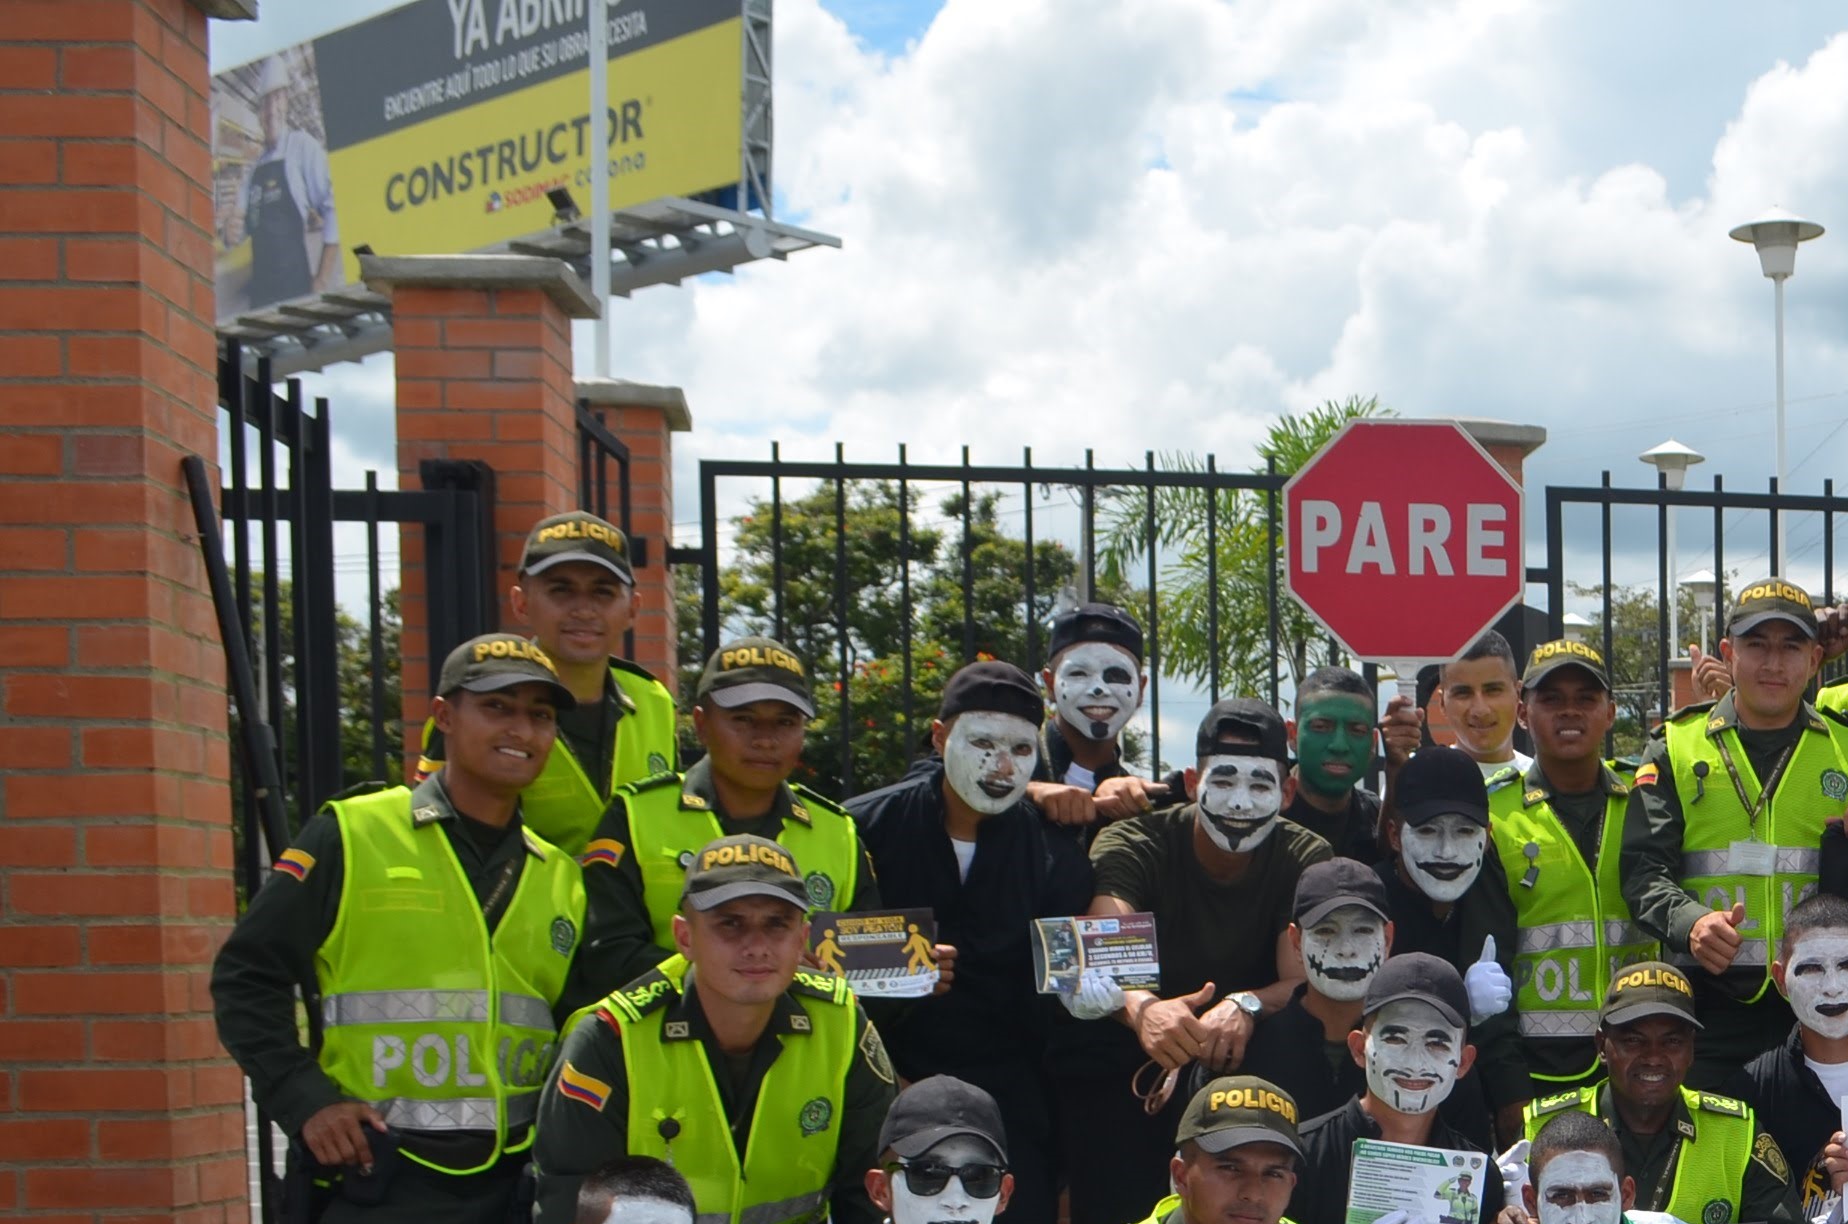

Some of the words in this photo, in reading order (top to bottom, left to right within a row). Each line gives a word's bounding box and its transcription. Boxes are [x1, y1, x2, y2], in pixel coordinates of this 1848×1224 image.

[447, 0, 488, 59] YA
[384, 79, 445, 120] ENCUENTRE
[445, 63, 472, 100] AQUÍ
[473, 60, 501, 91] TODO
[502, 55, 517, 82] LO
[517, 49, 542, 78] QUE
[541, 42, 558, 70] SU
[559, 29, 591, 62] OBRA
[575, 151, 645, 188] coona
[537, 520, 622, 552] POLICIA
[1300, 499, 1507, 577] PARE
[1739, 582, 1812, 610] POLICIA
[721, 647, 805, 678] POLICIA
[1534, 638, 1605, 665] POLICIA
[703, 843, 796, 877] POLICIA
[1616, 967, 1692, 998] POLICIA
[1209, 1089, 1297, 1123] POLICIA
